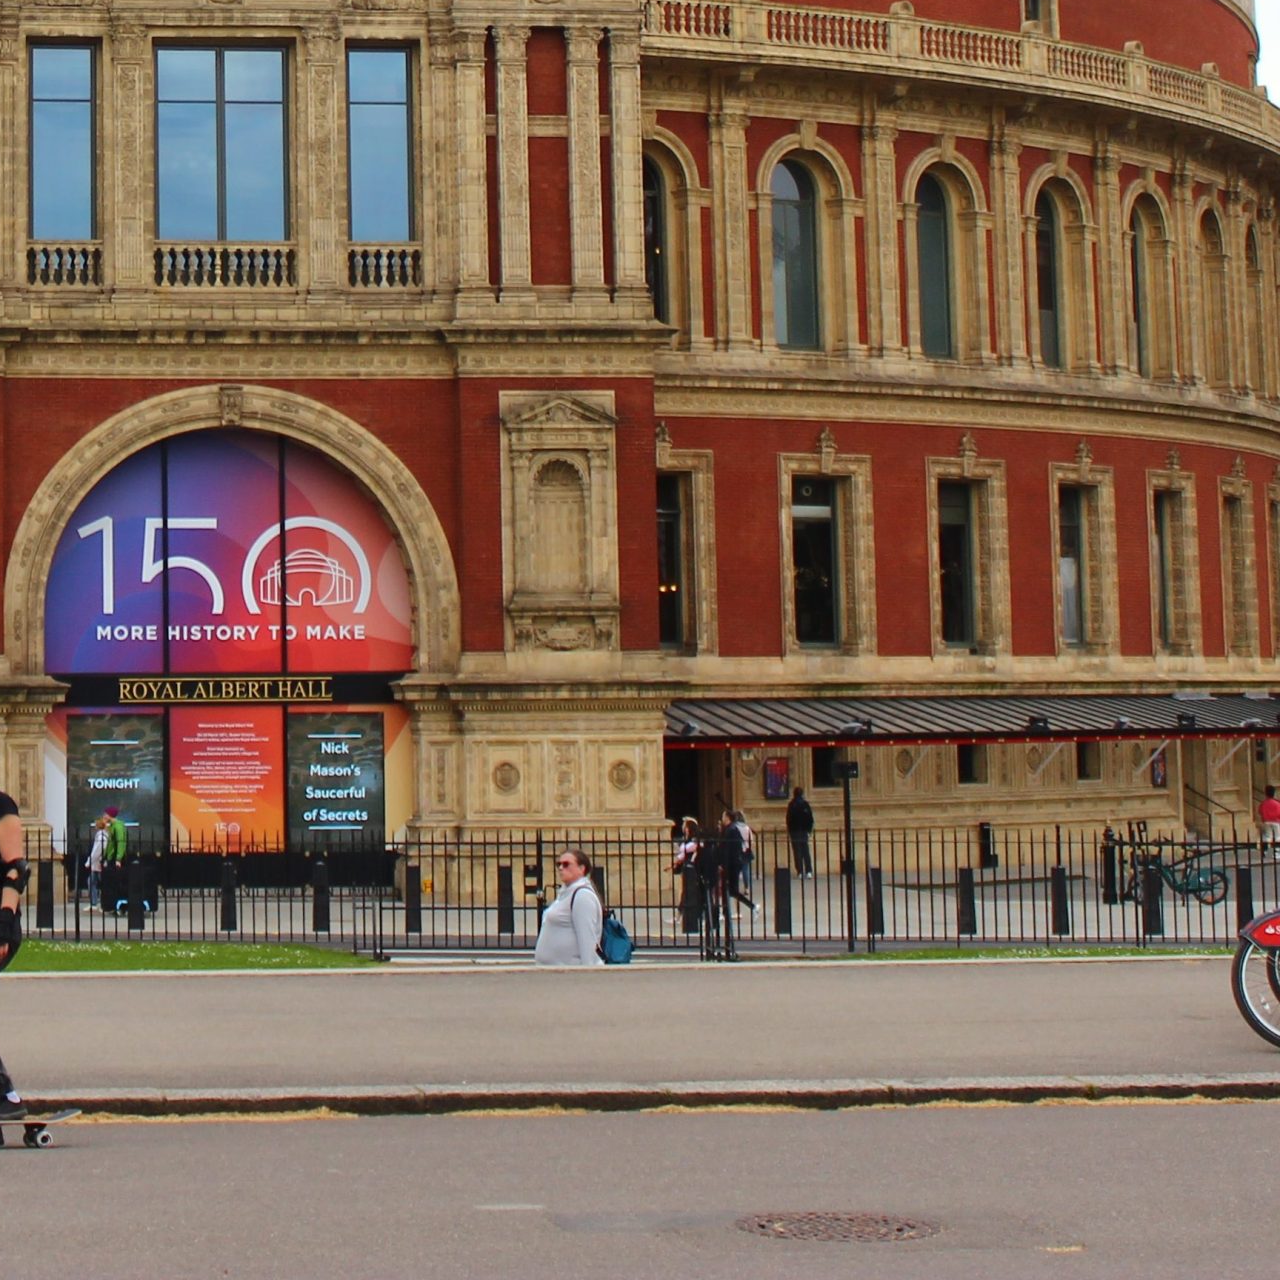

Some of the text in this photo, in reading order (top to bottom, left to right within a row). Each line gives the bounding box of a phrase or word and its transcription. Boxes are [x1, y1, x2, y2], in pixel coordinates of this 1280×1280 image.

[96, 624, 366, 641] MORE HISTORY TO MAKE
[119, 680, 333, 700] ROYAL ALBERT HALL
[321, 742, 349, 754] Nick
[310, 764, 361, 776] Mason's
[88, 778, 140, 789] TONIGHT
[306, 786, 366, 799] Saucerful
[303, 809, 368, 821] of Secrets
